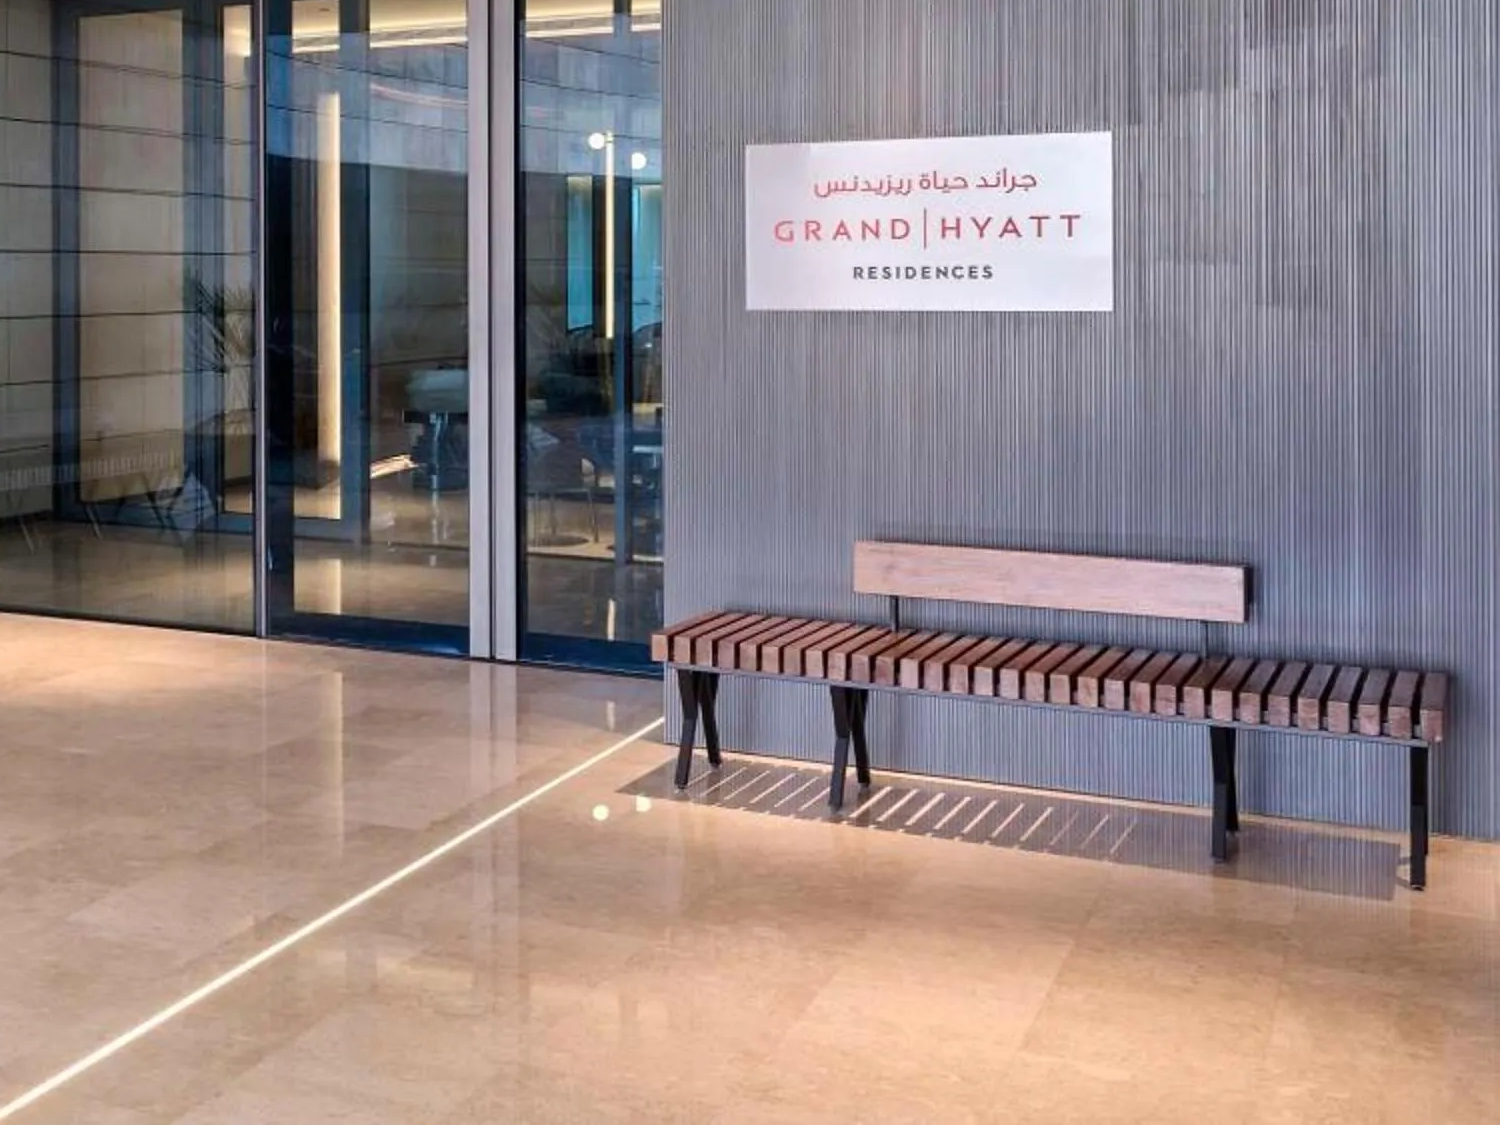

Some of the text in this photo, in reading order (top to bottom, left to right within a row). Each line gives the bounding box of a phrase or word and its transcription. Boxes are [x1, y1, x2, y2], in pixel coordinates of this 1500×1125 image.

[813, 168, 1037, 198] جراند حياة ريزيدنس
[773, 214, 1082, 243] GRAND HYATT
[852, 265, 994, 280] RESIDENCES
